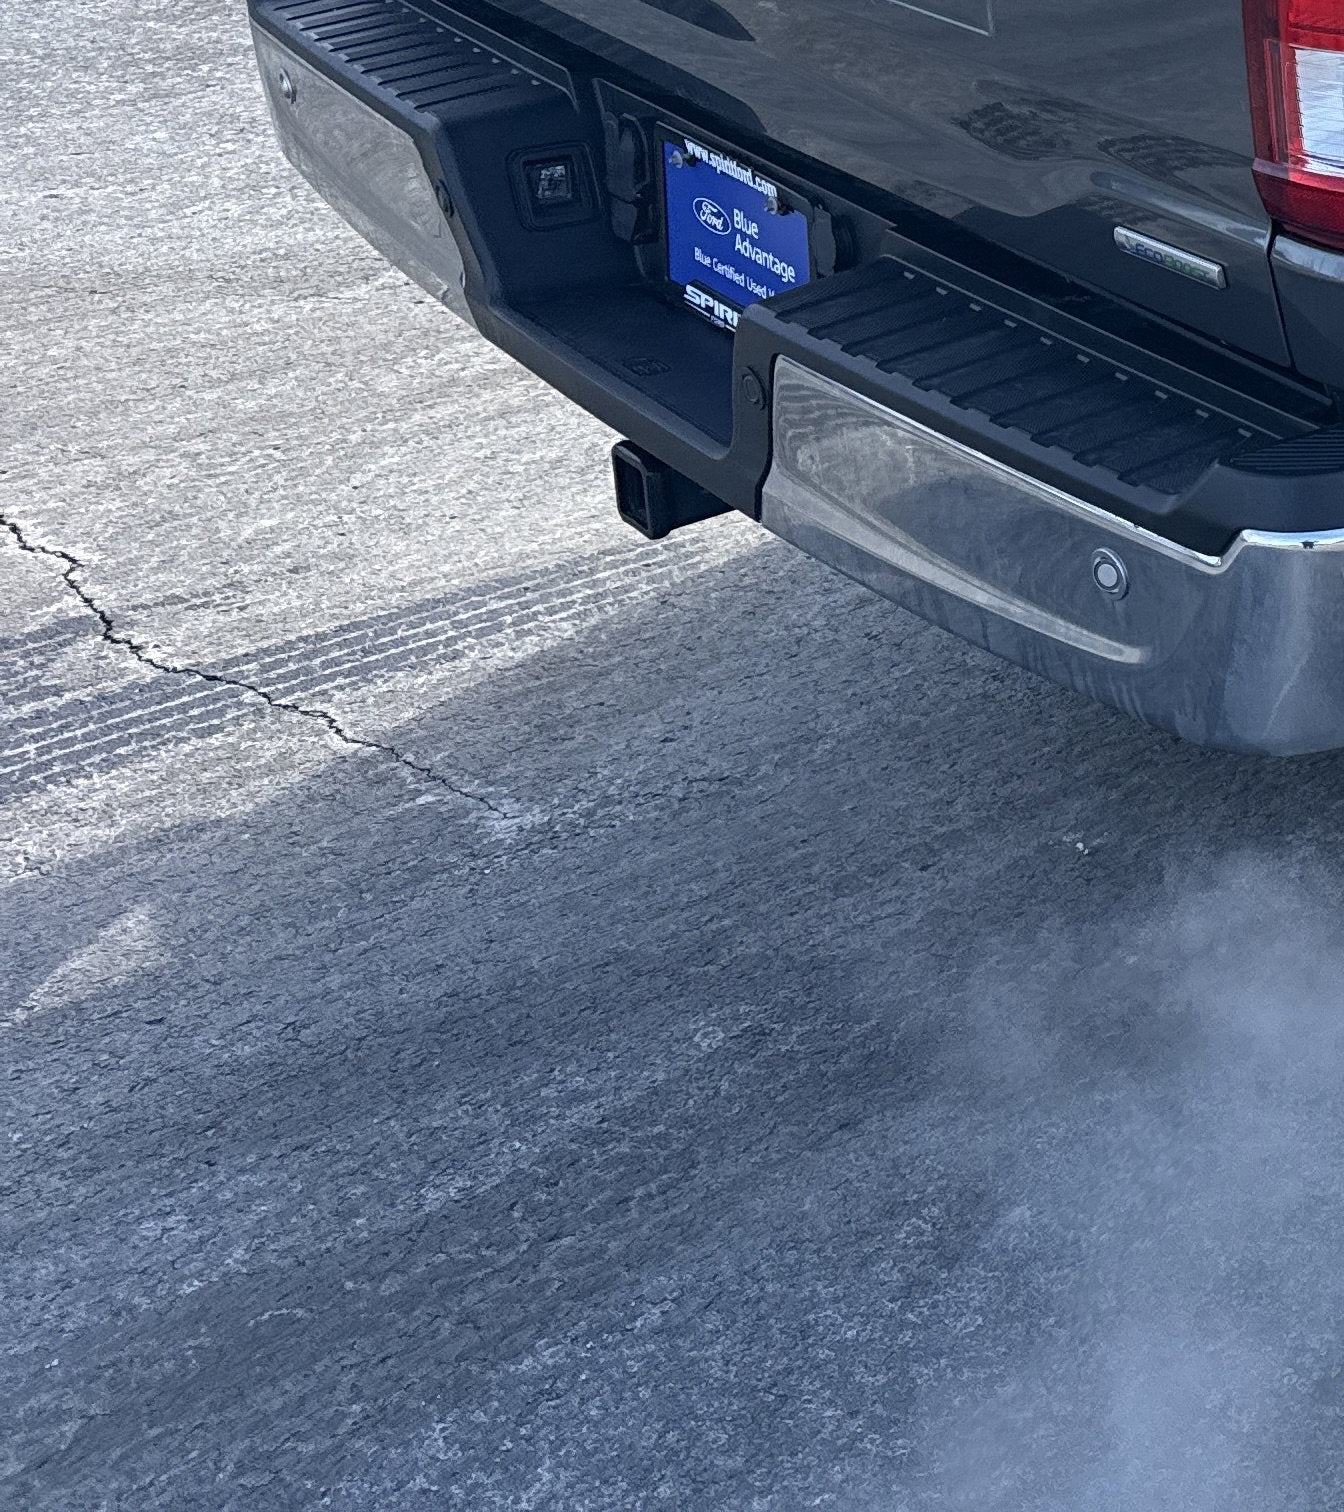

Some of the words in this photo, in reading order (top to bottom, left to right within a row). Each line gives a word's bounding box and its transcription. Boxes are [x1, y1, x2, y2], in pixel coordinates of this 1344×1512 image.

[683, 139, 778, 198] www.spiritford.com
[699, 201, 724, 231] Ford
[732, 207, 760, 240] Blue
[694, 246, 712, 268] Blue
[712, 257, 745, 288] Certified
[746, 276, 767, 300] Used
[734, 233, 797, 284] Advantage
